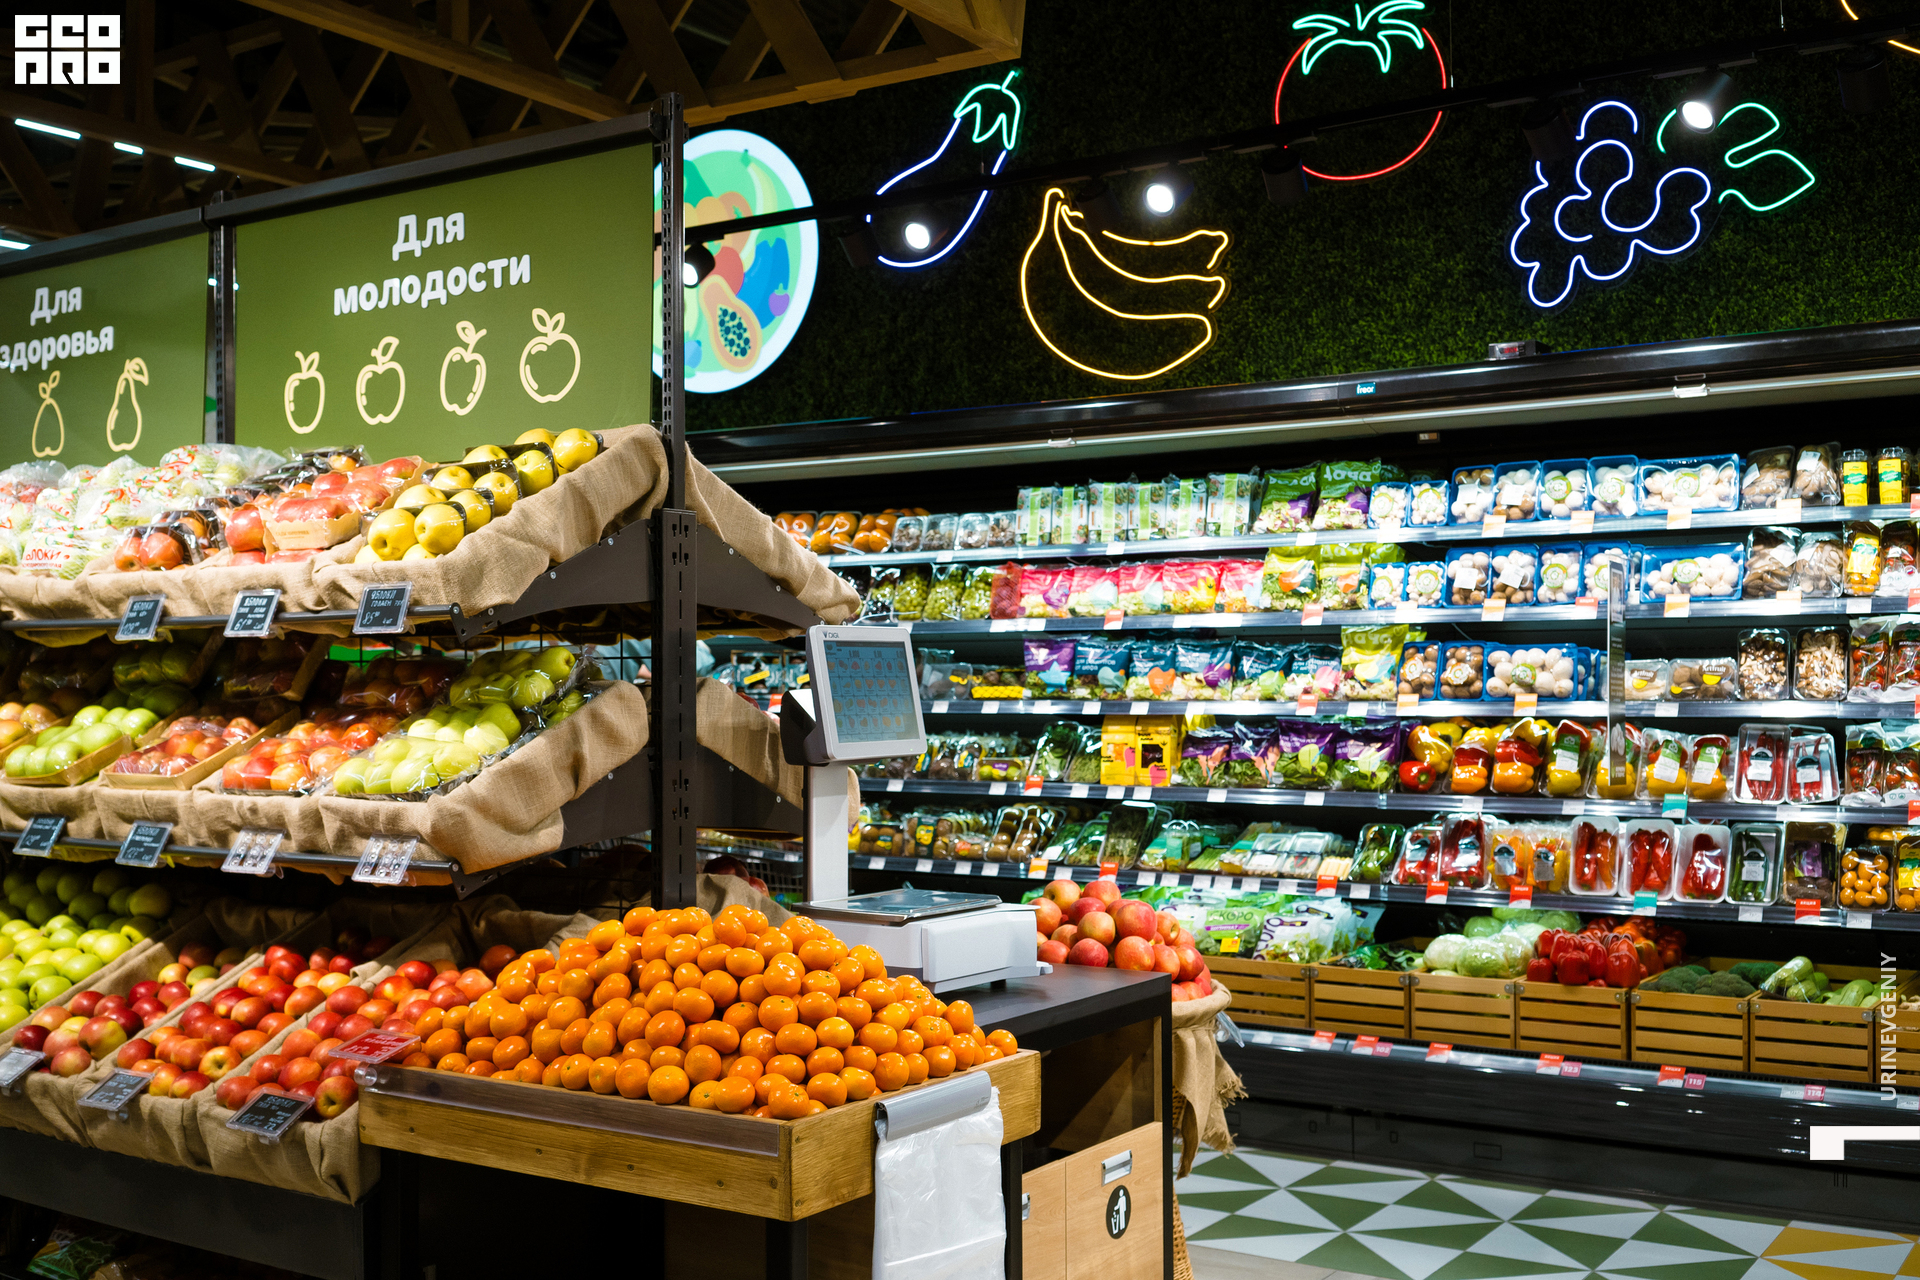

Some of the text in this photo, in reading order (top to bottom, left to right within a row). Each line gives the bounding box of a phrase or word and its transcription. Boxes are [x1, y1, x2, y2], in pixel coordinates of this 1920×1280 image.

[392, 212, 465, 262] Для
[30, 286, 82, 327] Для
[333, 254, 531, 316] молодости
[0, 325, 114, 374] здоровья
[1689, 1078, 1702, 1086] 115
